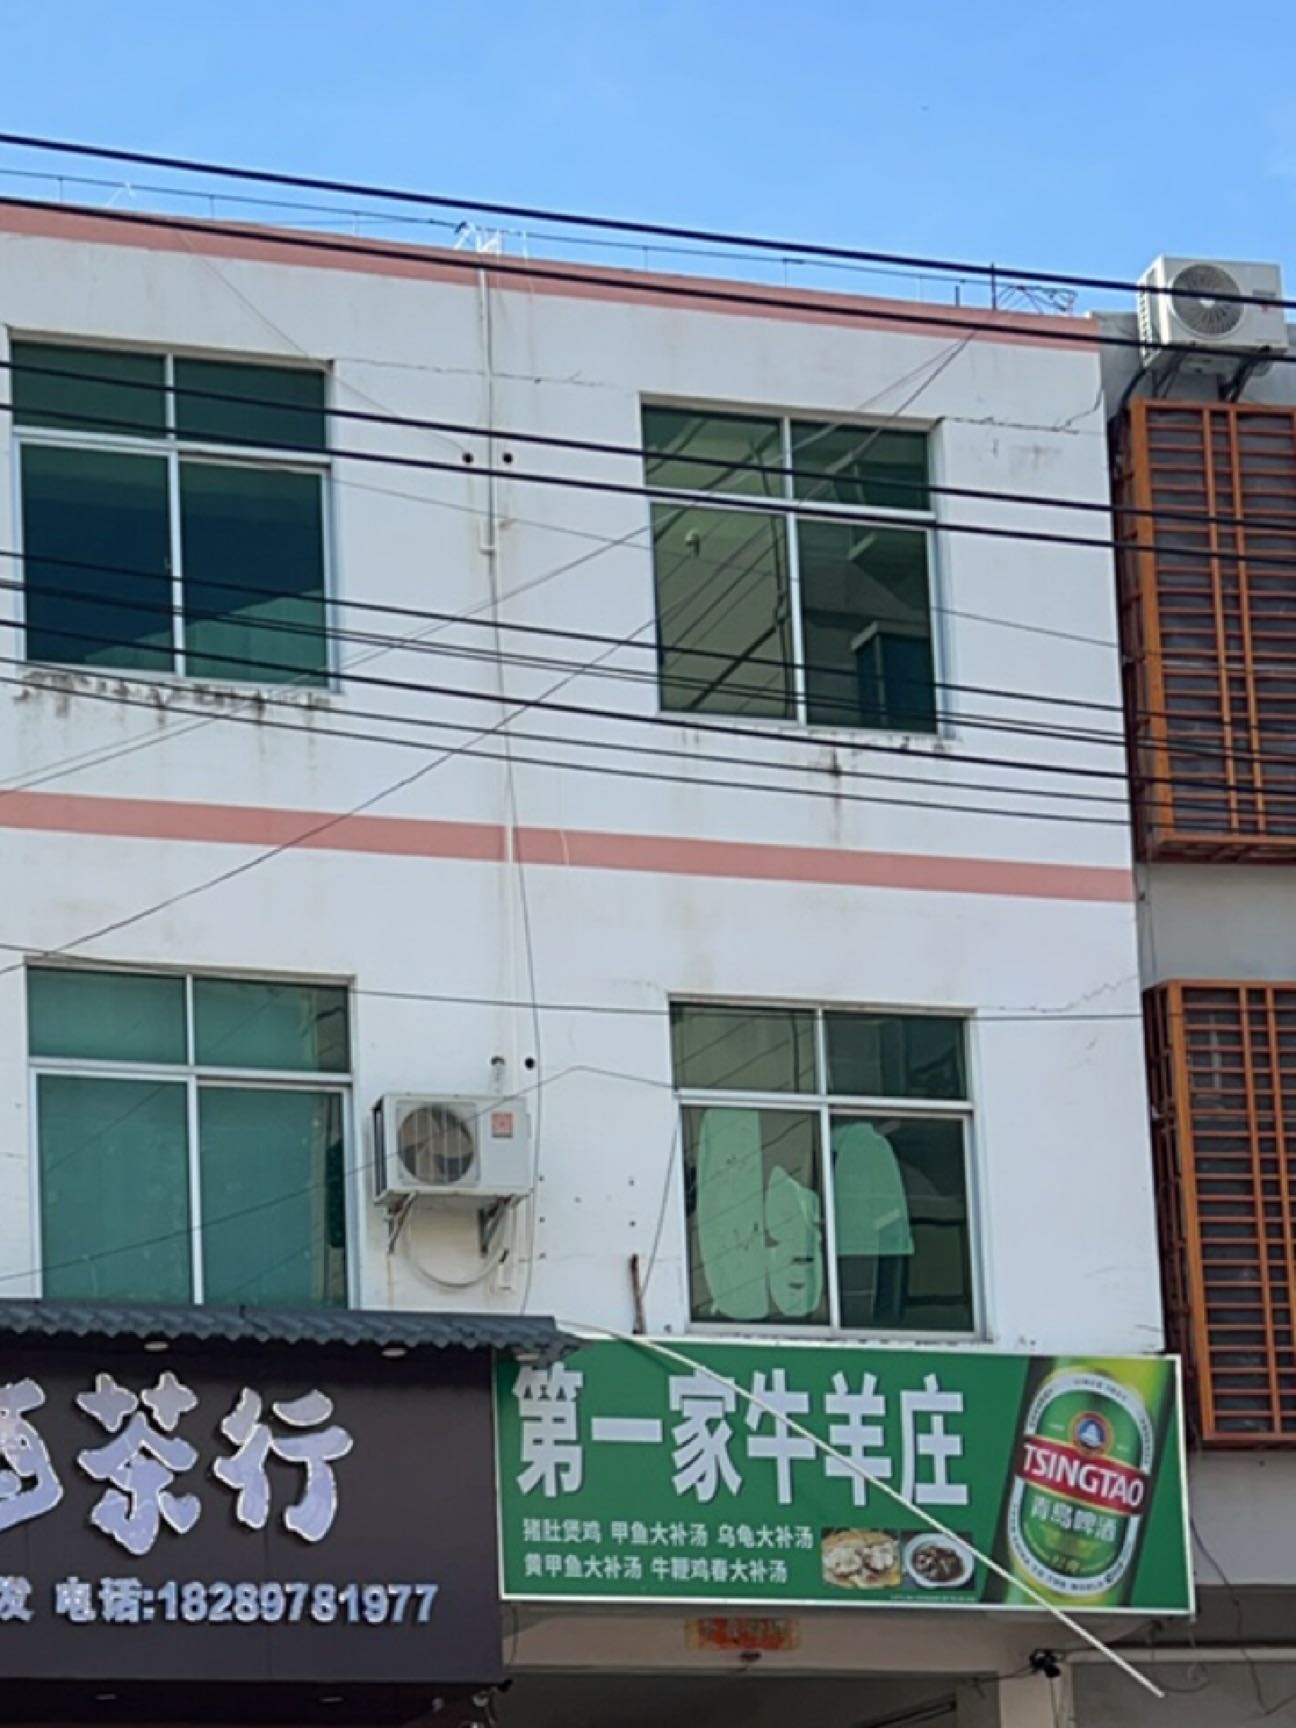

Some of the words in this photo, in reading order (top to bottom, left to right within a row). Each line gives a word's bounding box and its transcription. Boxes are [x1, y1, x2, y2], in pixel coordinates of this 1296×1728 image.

[512, 1360, 970, 1507] 第一家牛羊庄
[1022, 1443, 1145, 1508] TSINGTAO
[610, 1519, 709, 1548] 甲鱼大补汤
[1030, 1495, 1118, 1543] 青岛啤酒
[53, 1575, 440, 1624] 电话:18289781977
